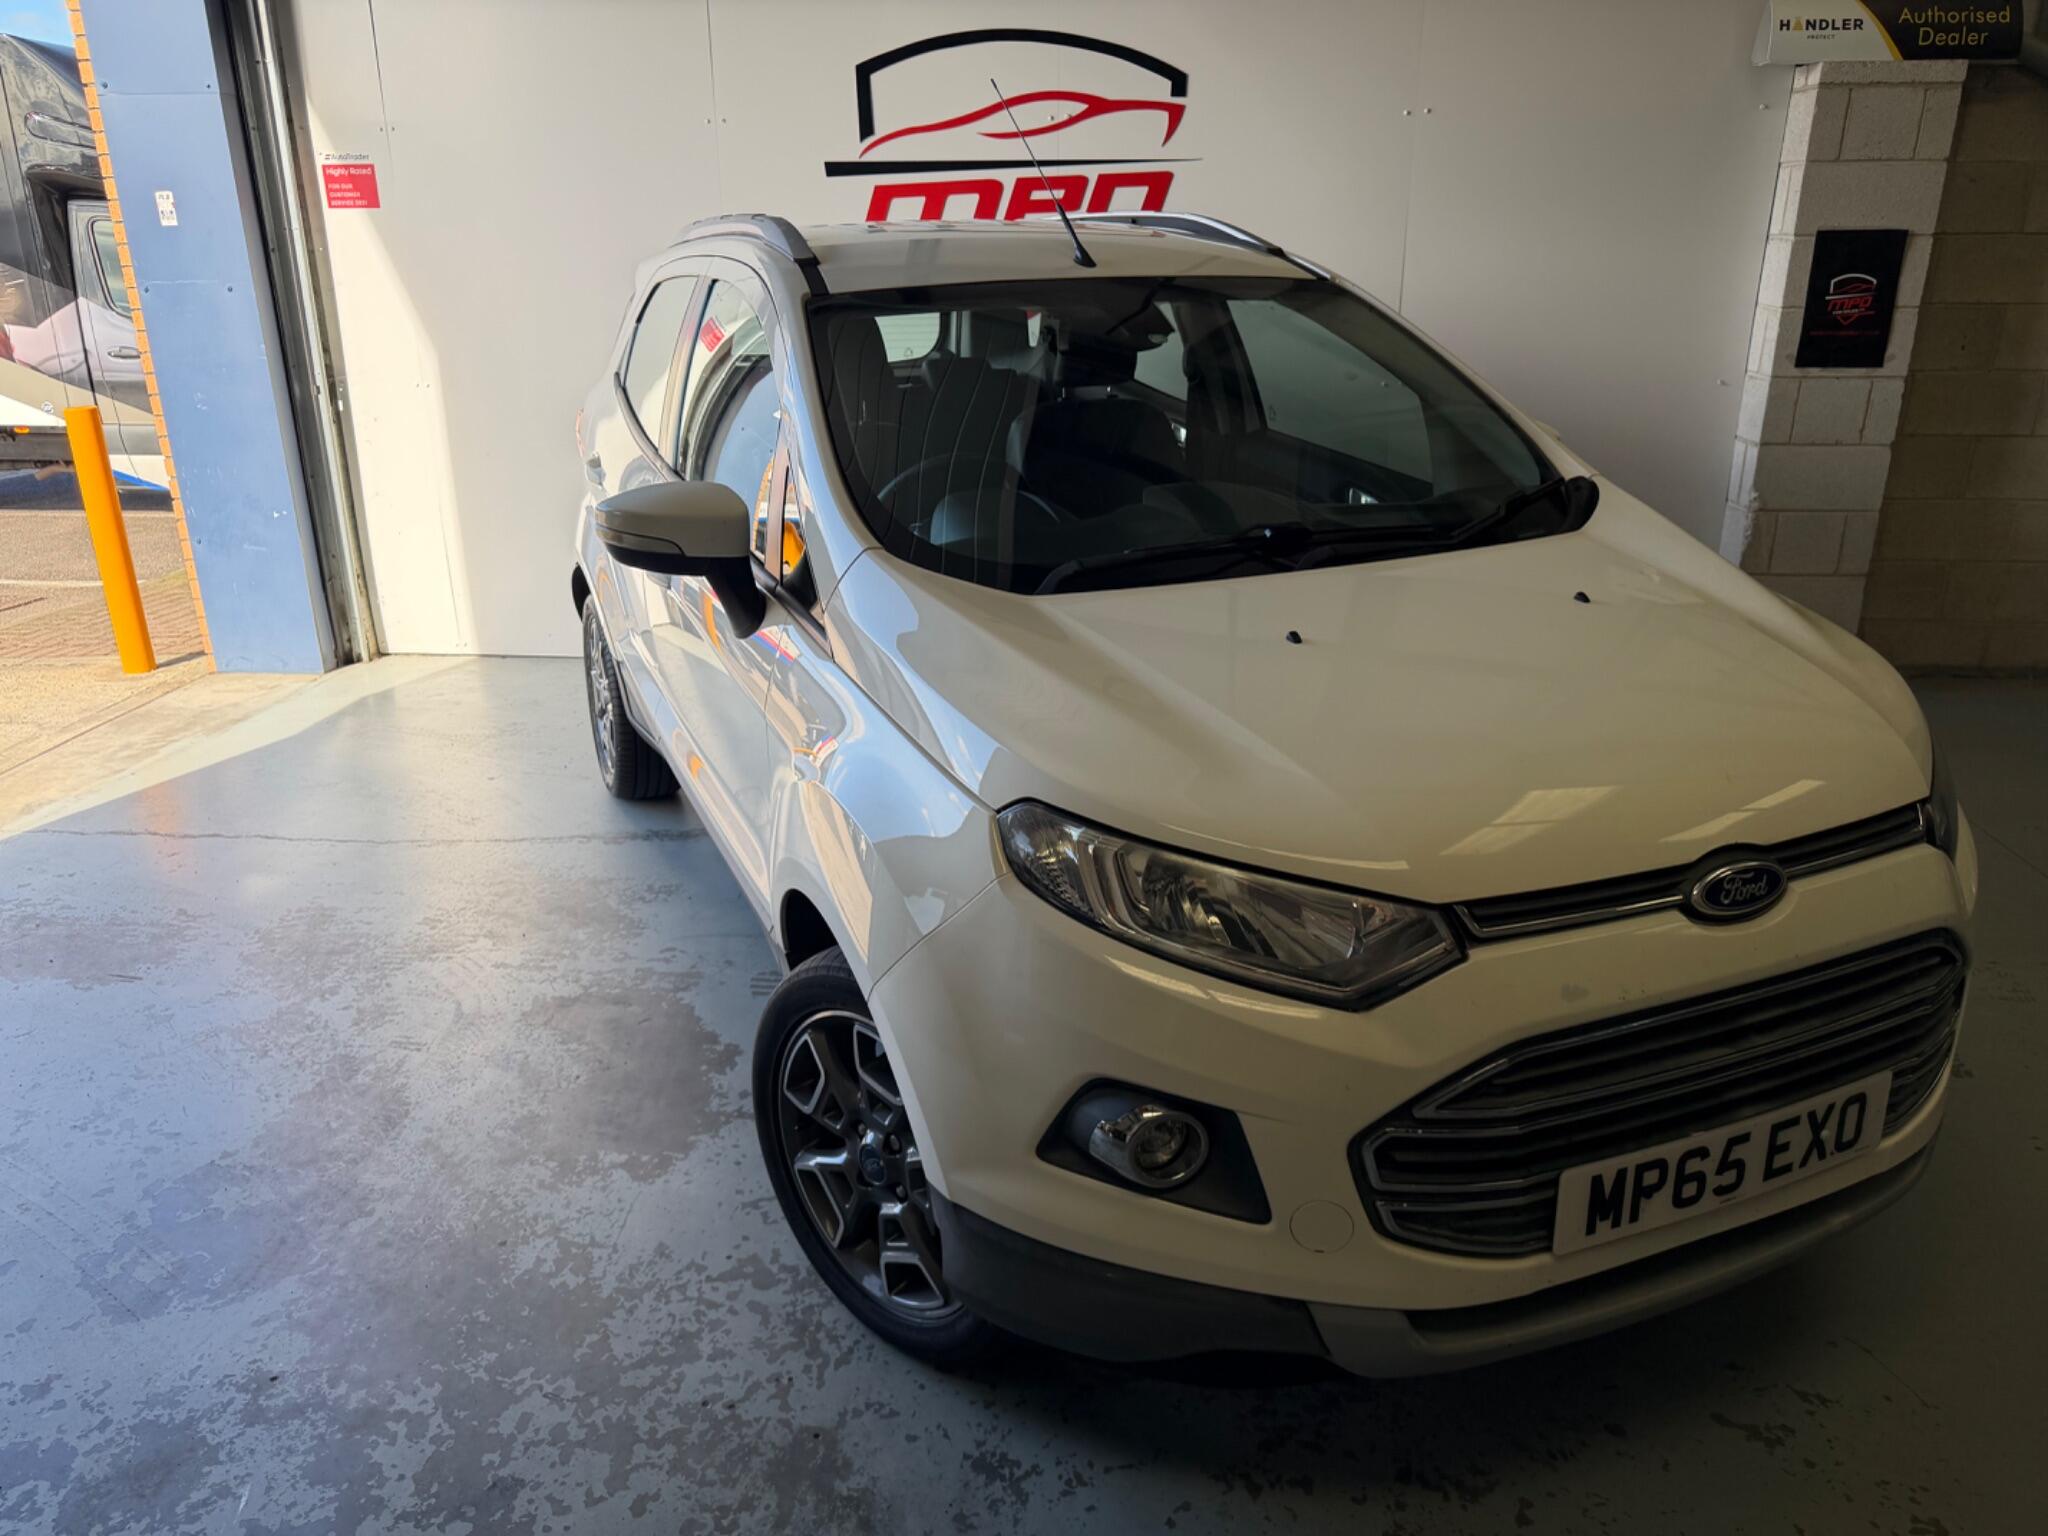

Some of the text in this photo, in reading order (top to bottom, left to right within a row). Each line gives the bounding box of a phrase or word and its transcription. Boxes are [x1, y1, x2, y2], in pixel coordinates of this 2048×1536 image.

[1779, 17, 1864, 31] HANDLER
[1898, 6, 2011, 24] Authorised
[1918, 27, 1989, 46] Dealer
[325, 167, 372, 177] Highly Rated
[1720, 871, 1769, 905] Ford
[1584, 1092, 1867, 1238] MP65 EXO
